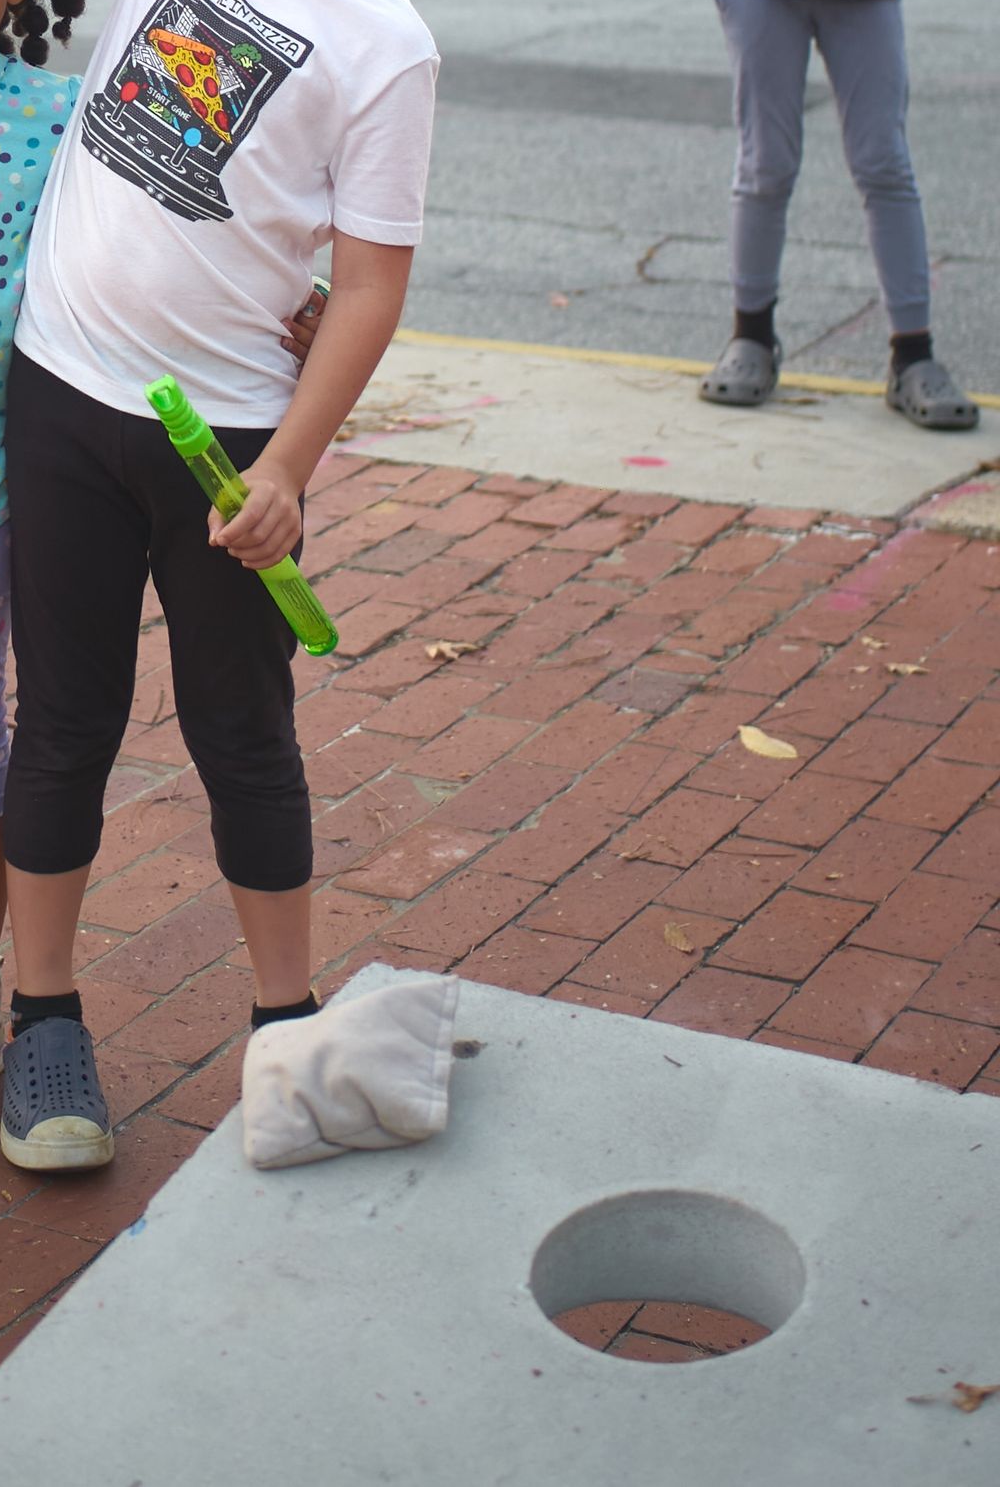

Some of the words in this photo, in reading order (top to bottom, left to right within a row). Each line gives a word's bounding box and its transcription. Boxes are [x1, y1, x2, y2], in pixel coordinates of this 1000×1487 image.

[249, 16, 299, 57] PIZZA
[146, 86, 171, 106] START
[170, 104, 191, 122] GAME
